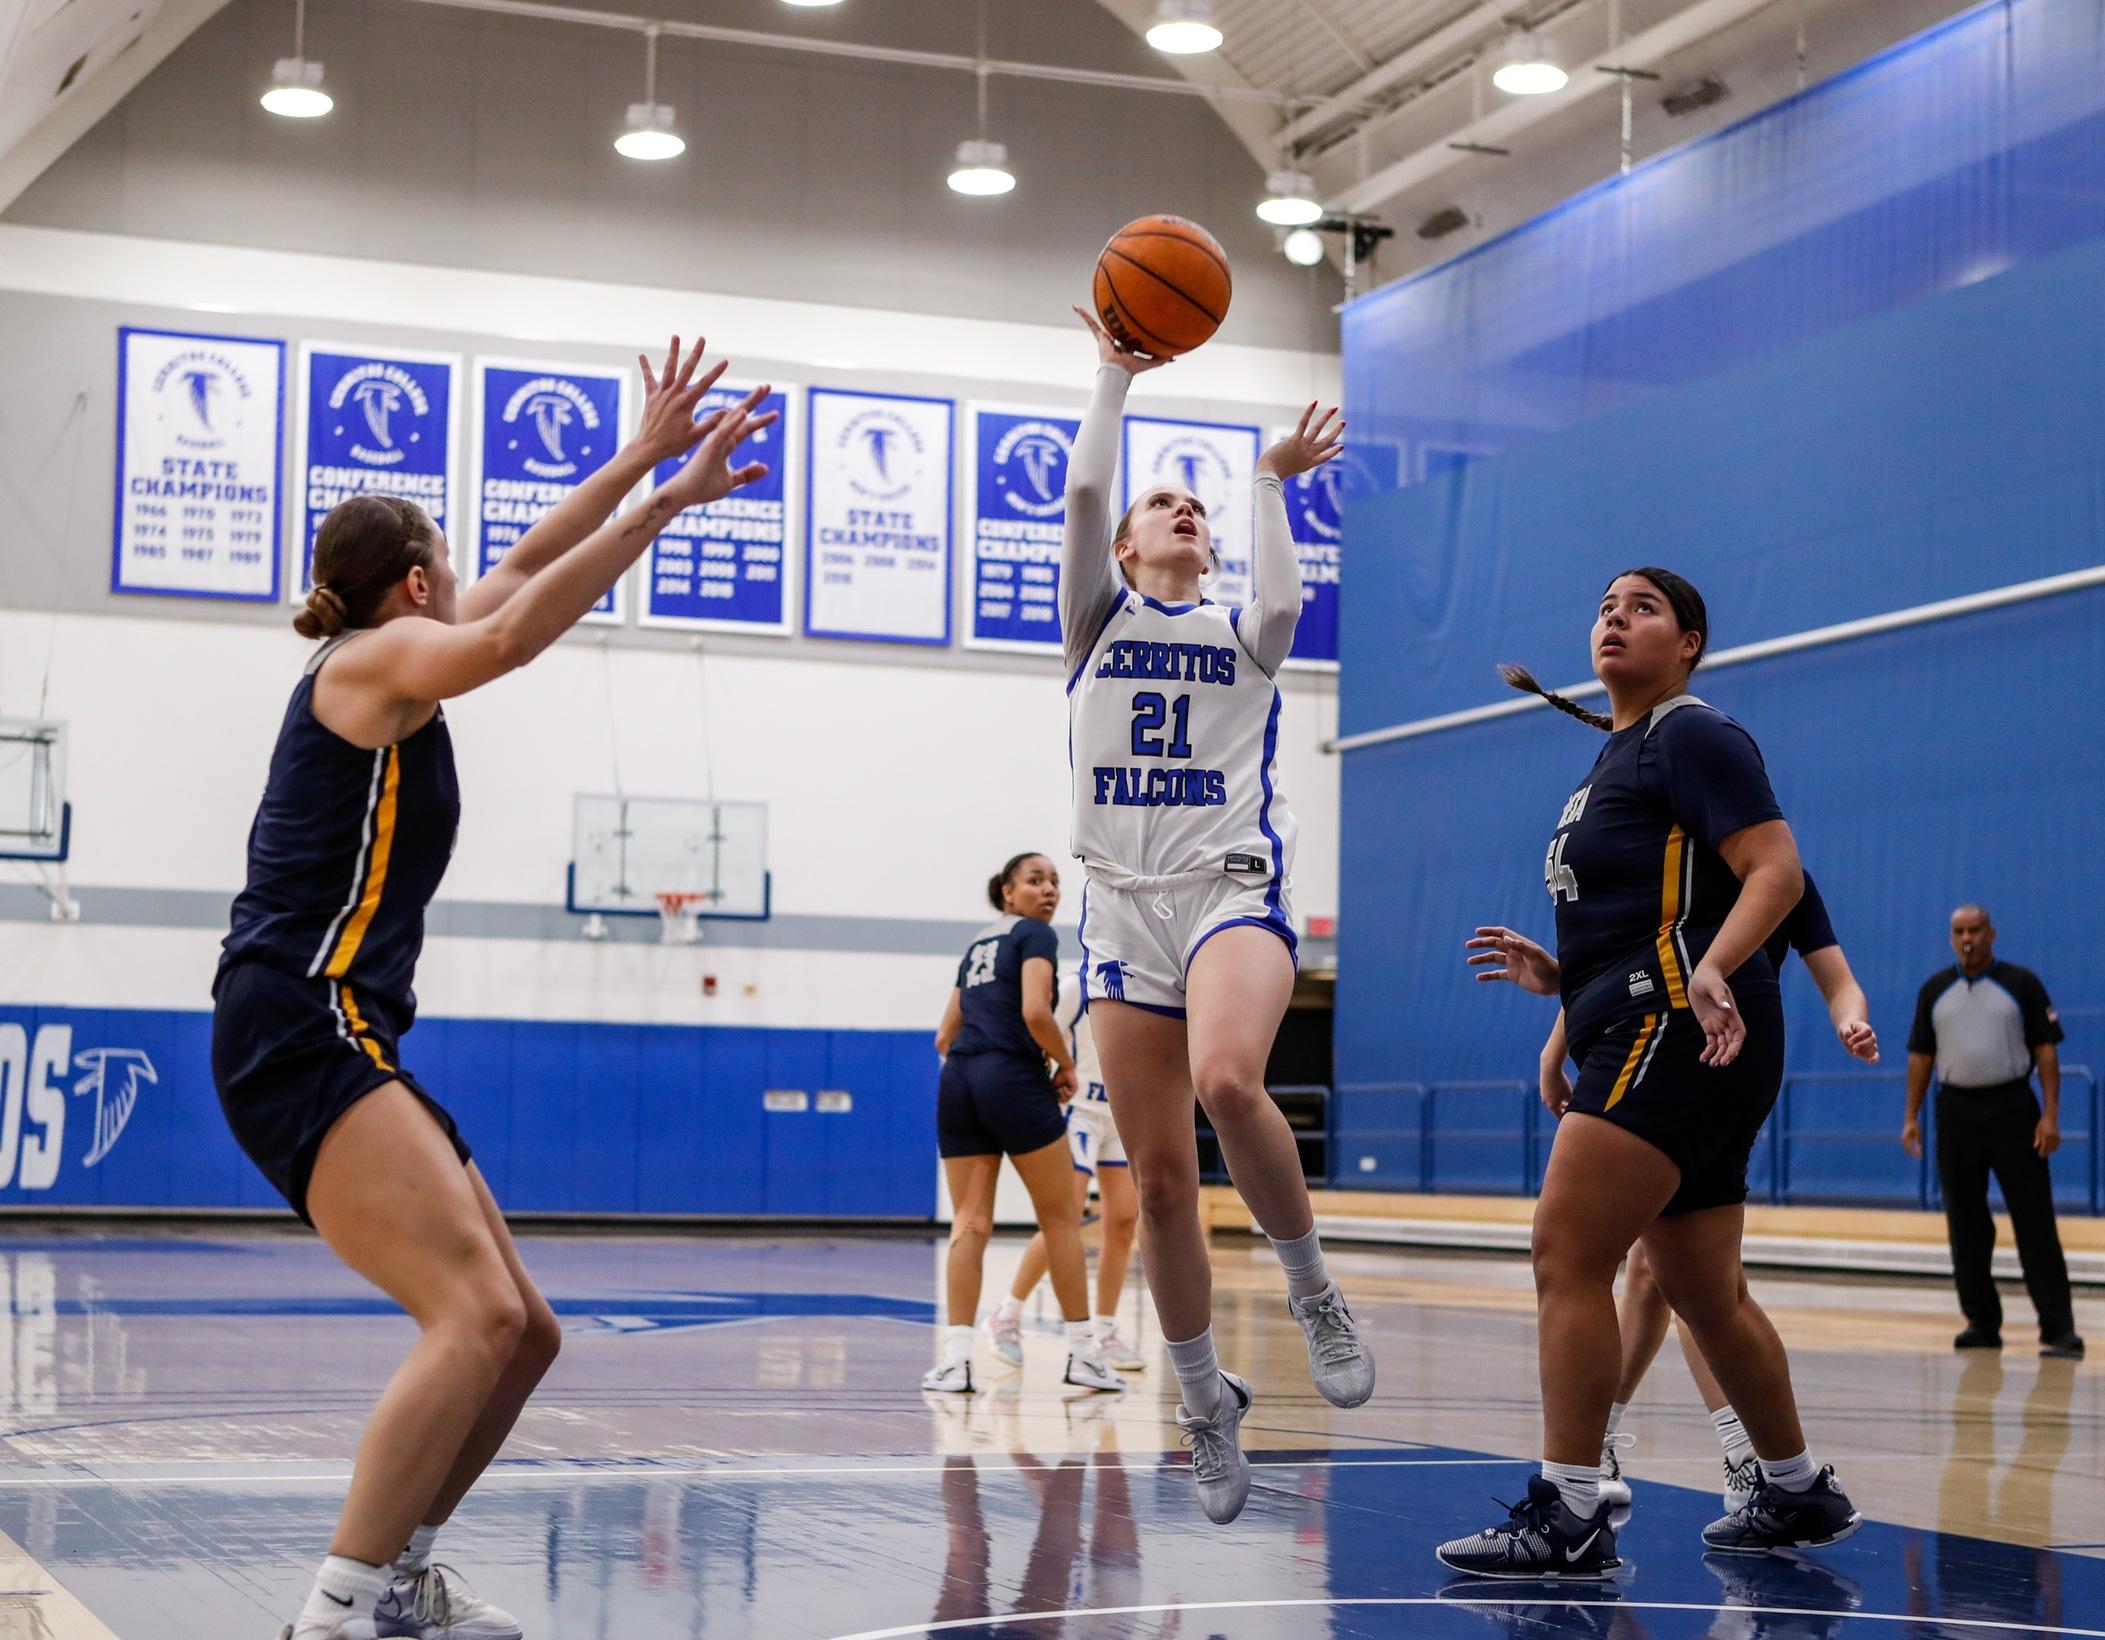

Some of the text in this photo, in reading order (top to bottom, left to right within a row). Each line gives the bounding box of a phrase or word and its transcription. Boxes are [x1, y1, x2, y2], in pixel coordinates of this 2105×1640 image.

[162, 457, 239, 480] STATE
[309, 465, 446, 496] CONFERENCE
[131, 477, 269, 504] CHAMPIONS
[308, 487, 446, 519] CHANS
[484, 479, 577, 503] CONFER
[660, 513, 783, 543] HAMPIONS
[848, 508, 914, 530] STATE
[978, 518, 1065, 543] CONFERE
[820, 527, 940, 553] CHAMPIONS
[978, 539, 1062, 565] CHAMPI
[1131, 691, 1192, 759] 21
[1093, 767, 1227, 806] FALCONS
[1628, 969, 1649, 983] 2XL
